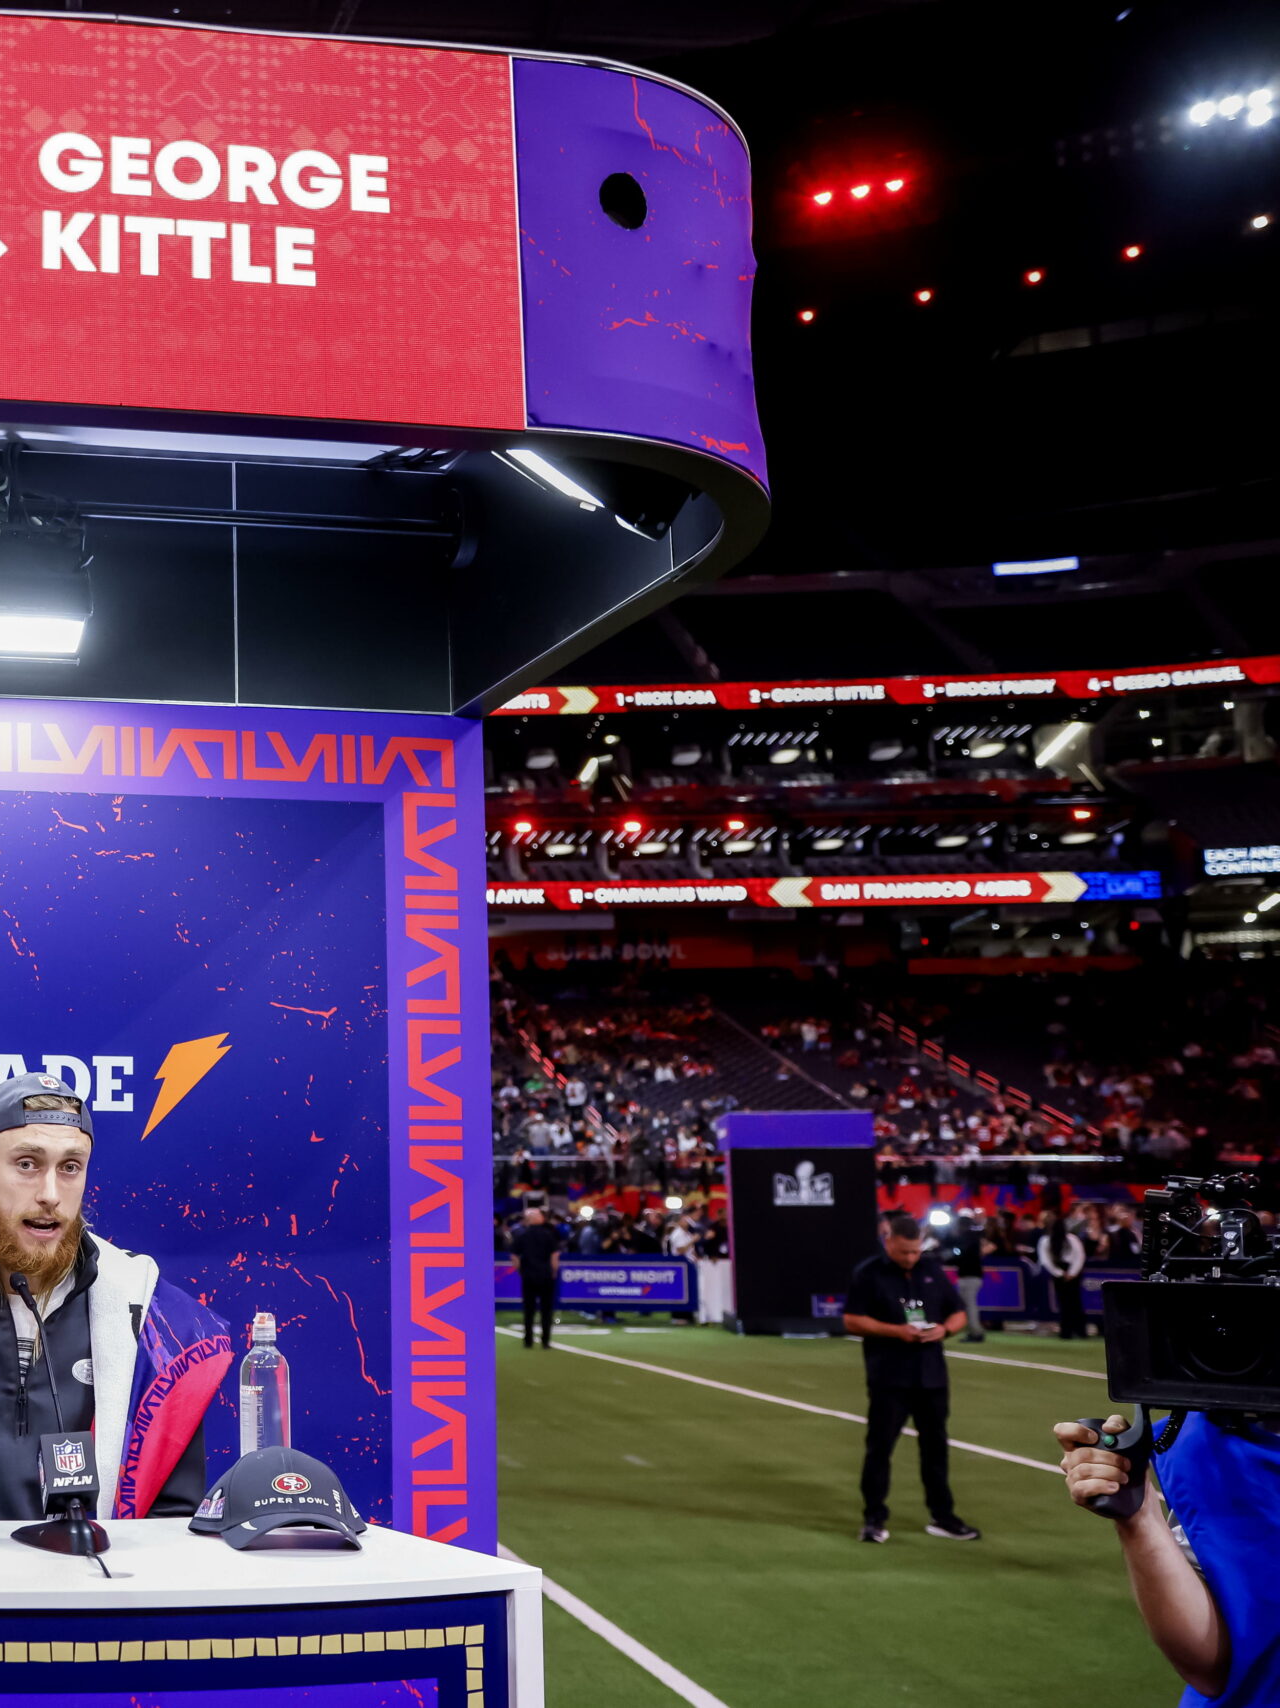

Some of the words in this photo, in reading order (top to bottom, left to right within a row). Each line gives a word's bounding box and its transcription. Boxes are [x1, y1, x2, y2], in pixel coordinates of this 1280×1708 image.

[39, 132, 390, 213] GEORGE
[43, 210, 317, 287] KITTLE
[696, 886, 747, 901] WARD
[821, 884, 860, 900] SAN
[863, 881, 971, 899] FRANCISCO
[974, 880, 1031, 896] 49ERS
[561, 1268, 627, 1284] OPENING
[630, 1269, 676, 1285] NIGHT
[59, 1455, 81, 1470] NFL
[53, 1475, 93, 1487] NFLN
[254, 1497, 293, 1507] SUPER
[298, 1497, 329, 1506] BOWL
